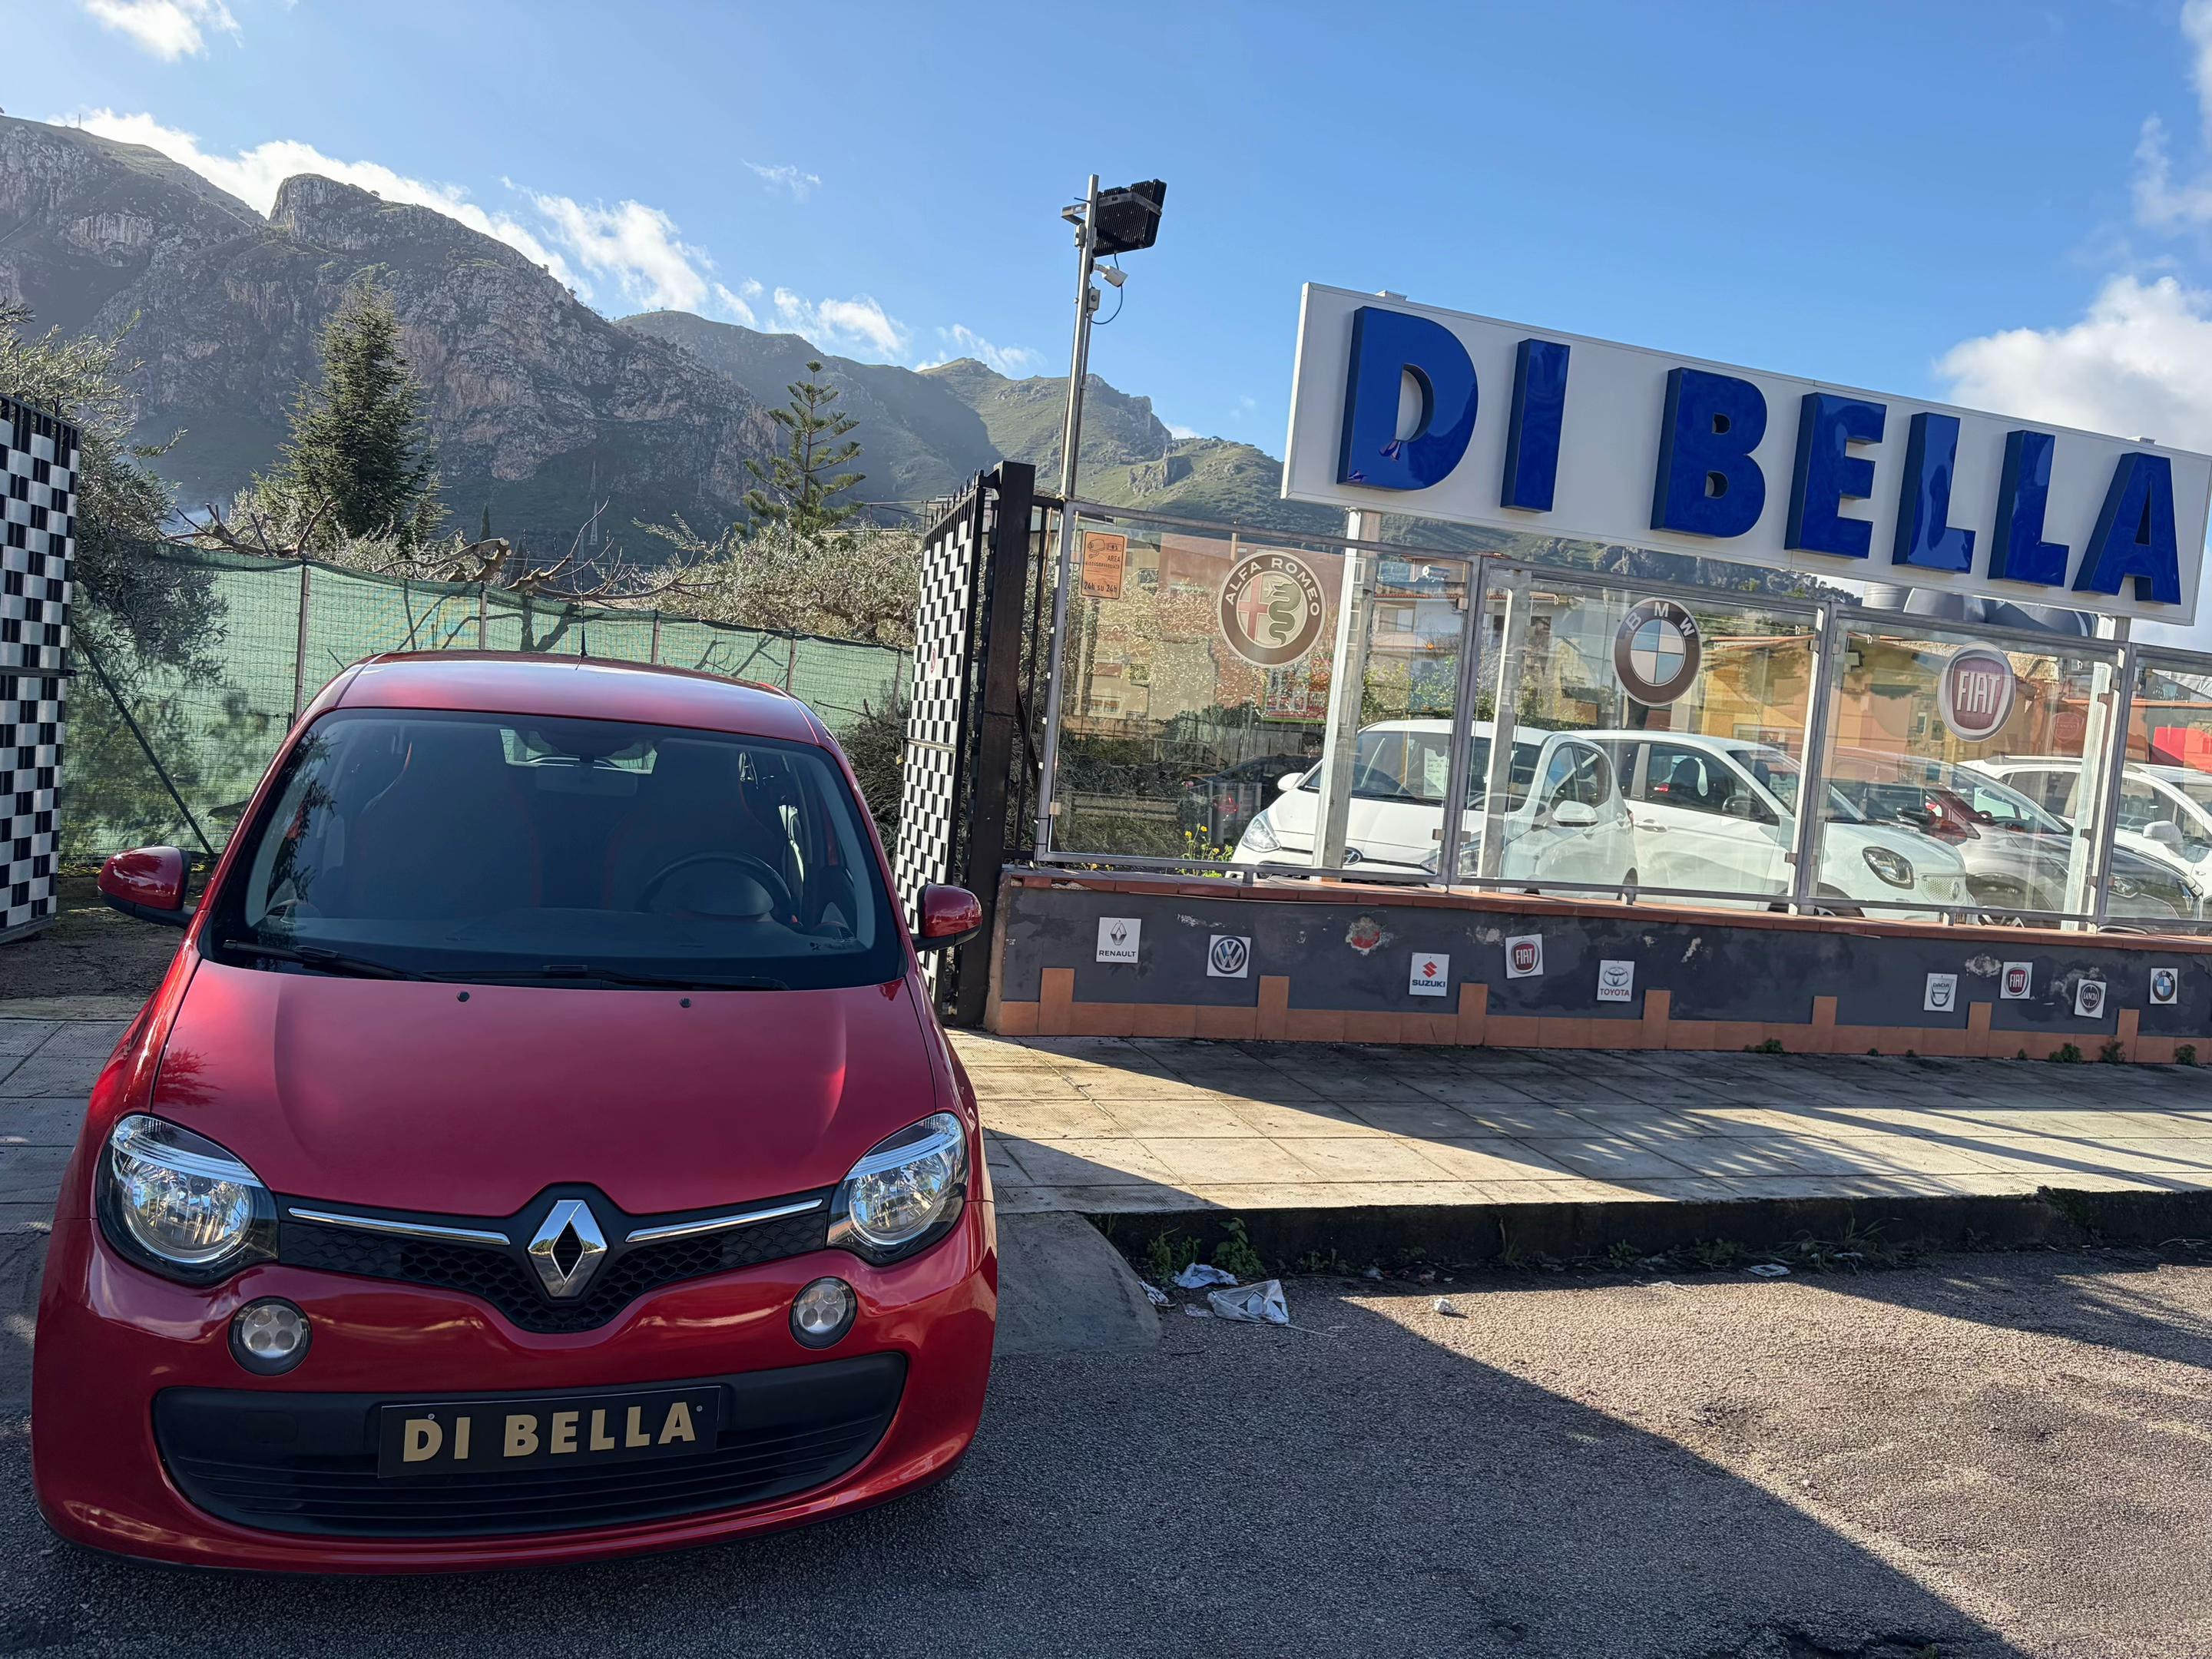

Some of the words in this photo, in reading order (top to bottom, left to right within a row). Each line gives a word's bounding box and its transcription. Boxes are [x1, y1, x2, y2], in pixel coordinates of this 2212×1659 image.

[1337, 306, 1571, 512] DI
[1650, 367, 2181, 605] BELLA
[1084, 581, 1095, 591] 24h
[1106, 584, 1118, 593] 24h
[1225, 561, 1262, 606] ALFA
[1271, 557, 1320, 616] ROMEO
[1624, 601, 1696, 637] BMW
[1956, 671, 2001, 715] FIAT
[1515, 948, 1534, 965] FIAT
[1412, 979, 1446, 988] SUZUKI
[2009, 974, 2025, 988] FIAT
[402, 1416, 471, 1462] DI
[503, 1402, 696, 1458] BELLA
